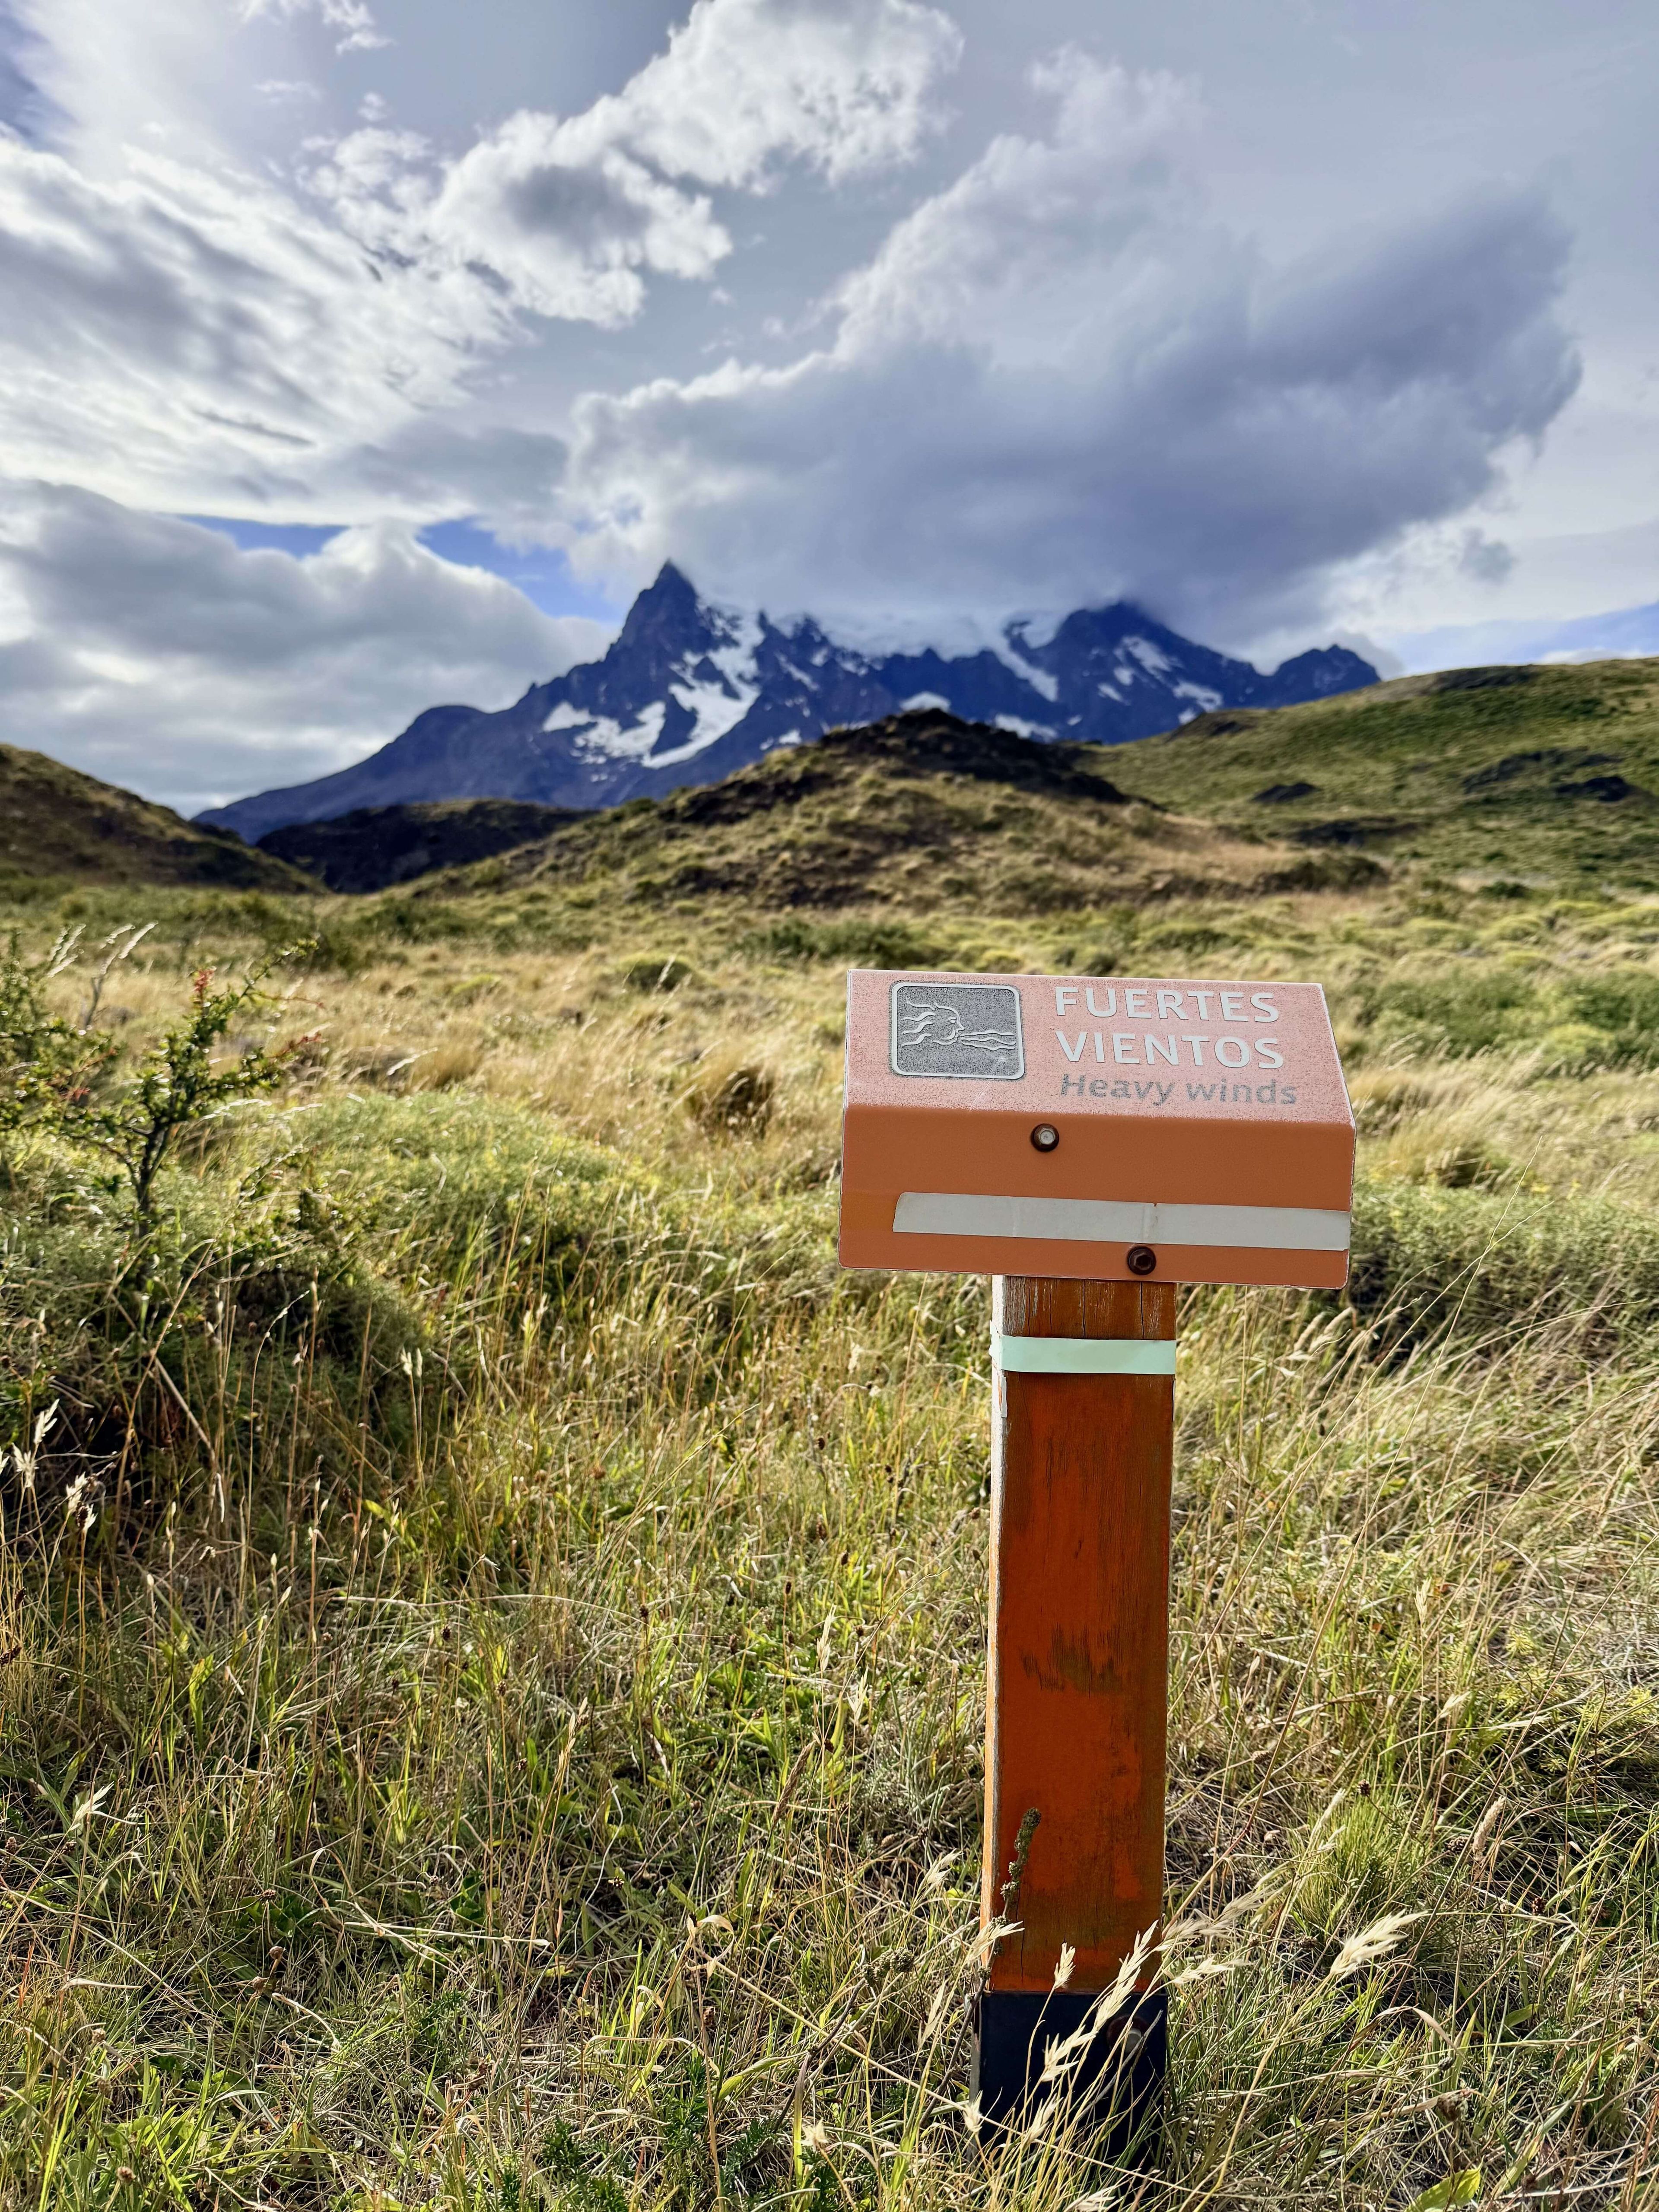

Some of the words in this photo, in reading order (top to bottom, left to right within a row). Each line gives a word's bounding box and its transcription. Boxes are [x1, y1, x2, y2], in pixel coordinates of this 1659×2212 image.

[1055, 986, 1279, 1023] FUERTES
[1055, 1030, 1284, 1069] VIENTOS
[1060, 1073, 1175, 1106] Heavy
[1185, 1078, 1297, 1105] winds
